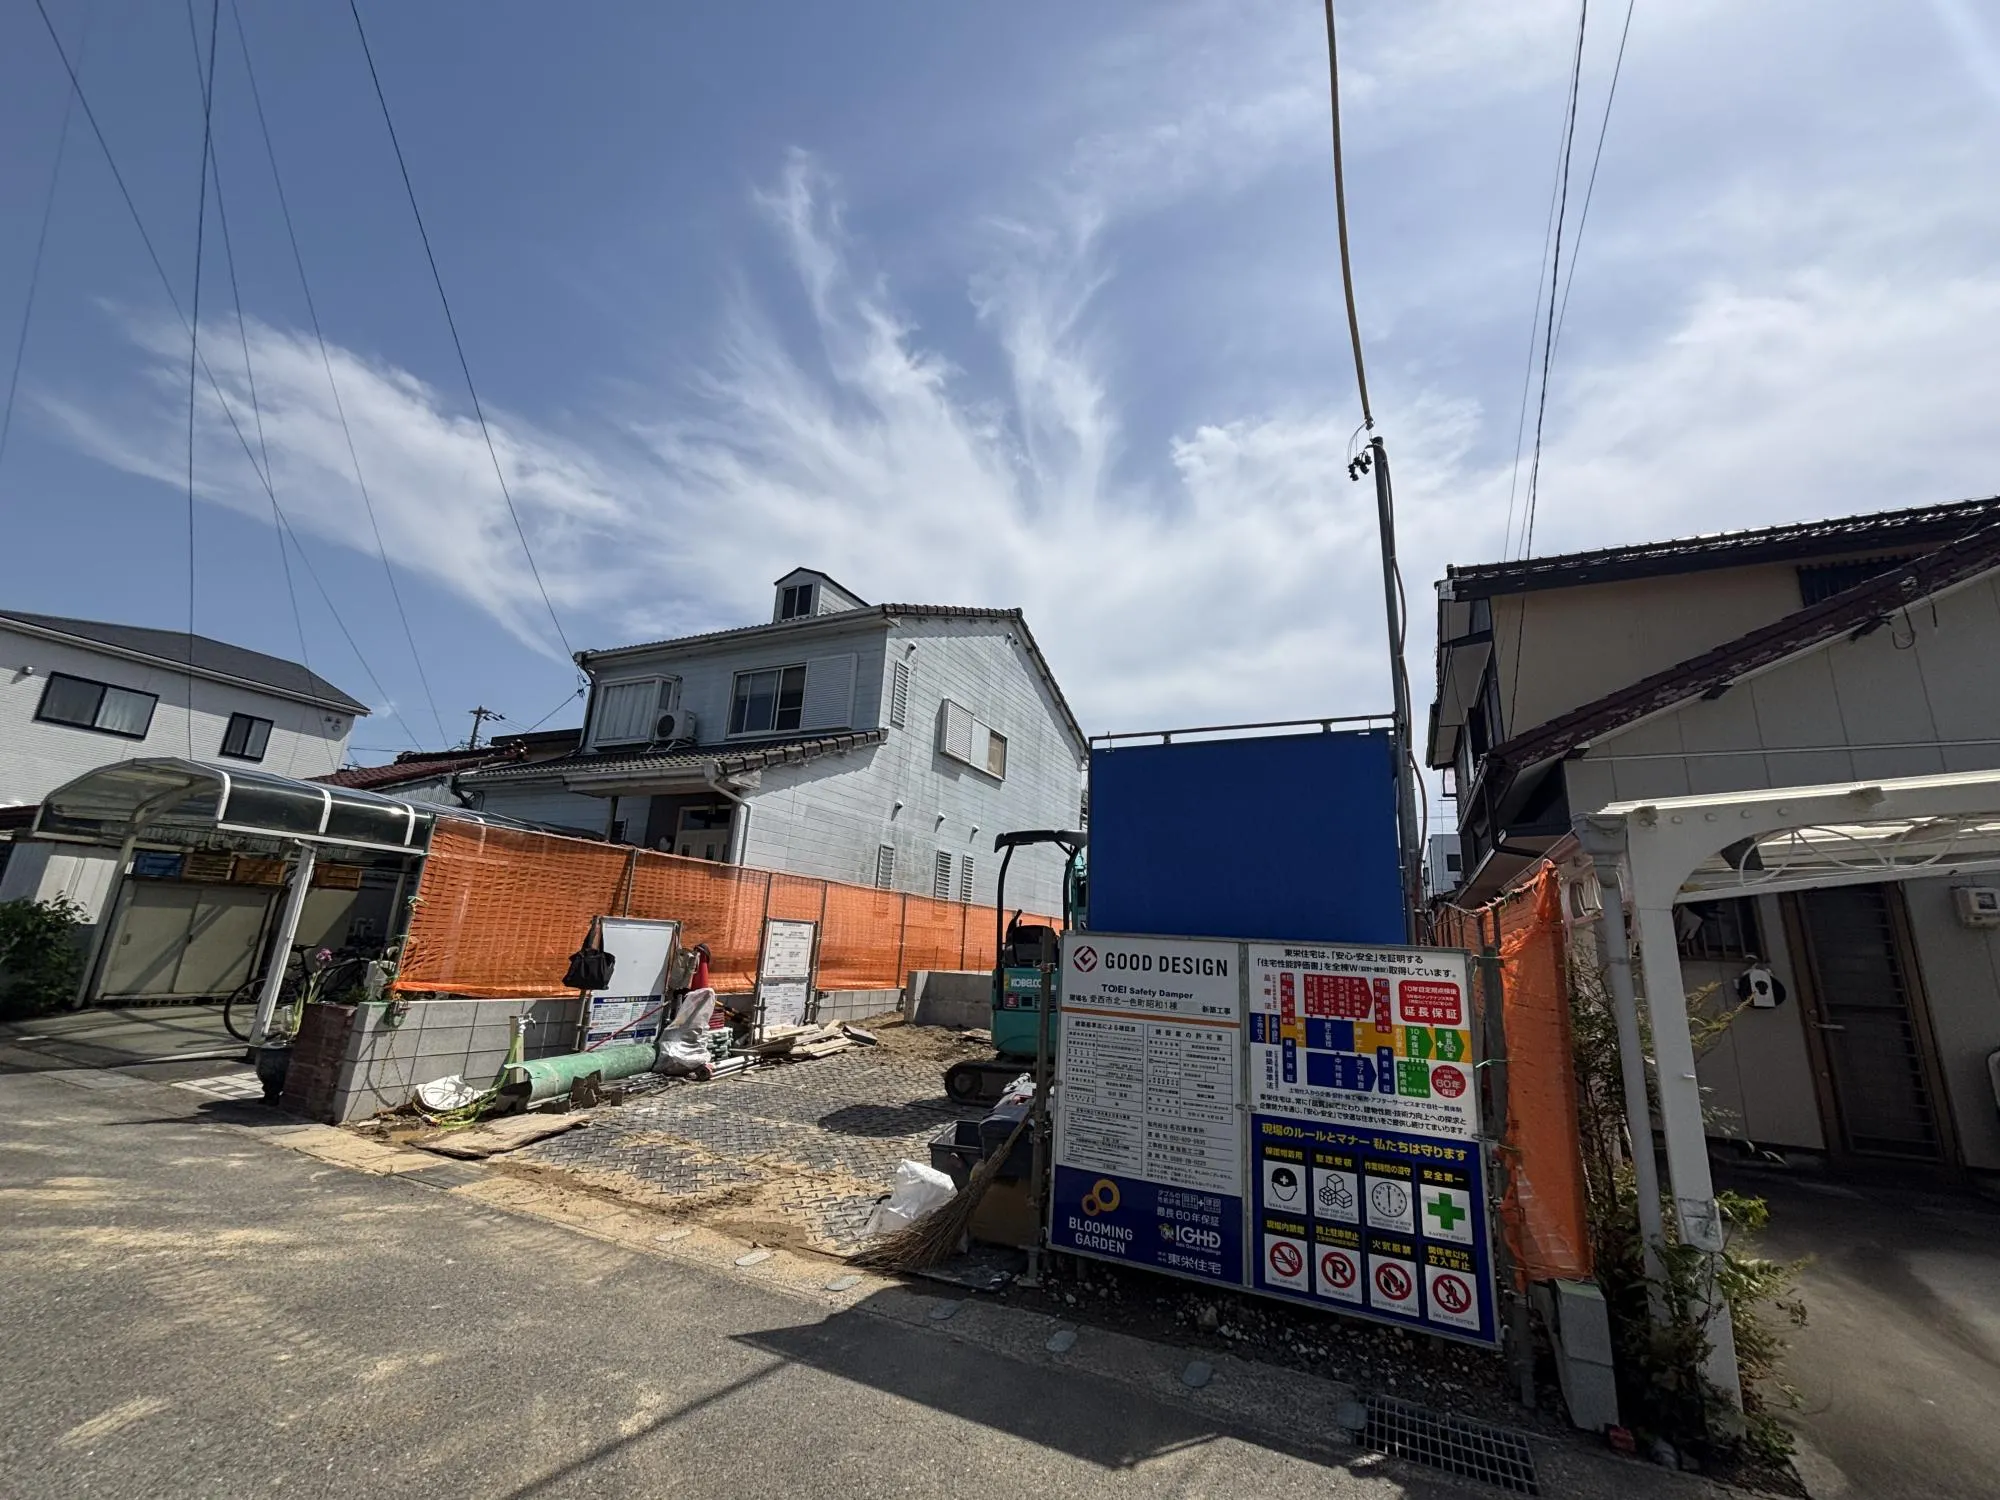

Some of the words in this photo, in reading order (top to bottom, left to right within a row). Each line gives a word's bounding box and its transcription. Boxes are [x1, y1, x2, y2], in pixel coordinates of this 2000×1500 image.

[1105, 952, 1152, 971] GOOD
[1159, 955, 1228, 977] DESIGN
[1129, 986, 1157, 998] Safety
[1159, 988, 1194, 1000] Damper
[1404, 1006, 1458, 1020] 延長保証
[1435, 1079, 1461, 1089] 60年
[1442, 1088, 1457, 1097] 保証
[1261, 1122, 1370, 1145] 現場のルールとマナー
[1373, 1137, 1468, 1161] 私たちは守ります
[1423, 1170, 1465, 1183] 安全第一
[1156, 1206, 1220, 1227] 最長60年保証
[1068, 1215, 1133, 1241] BLOOMING
[1175, 1224, 1221, 1248] IGHD
[1075, 1232, 1126, 1255] GARDEN
[1167, 1252, 1221, 1275] 東栄住宅
[1428, 1255, 1471, 1271] 立入禁止
